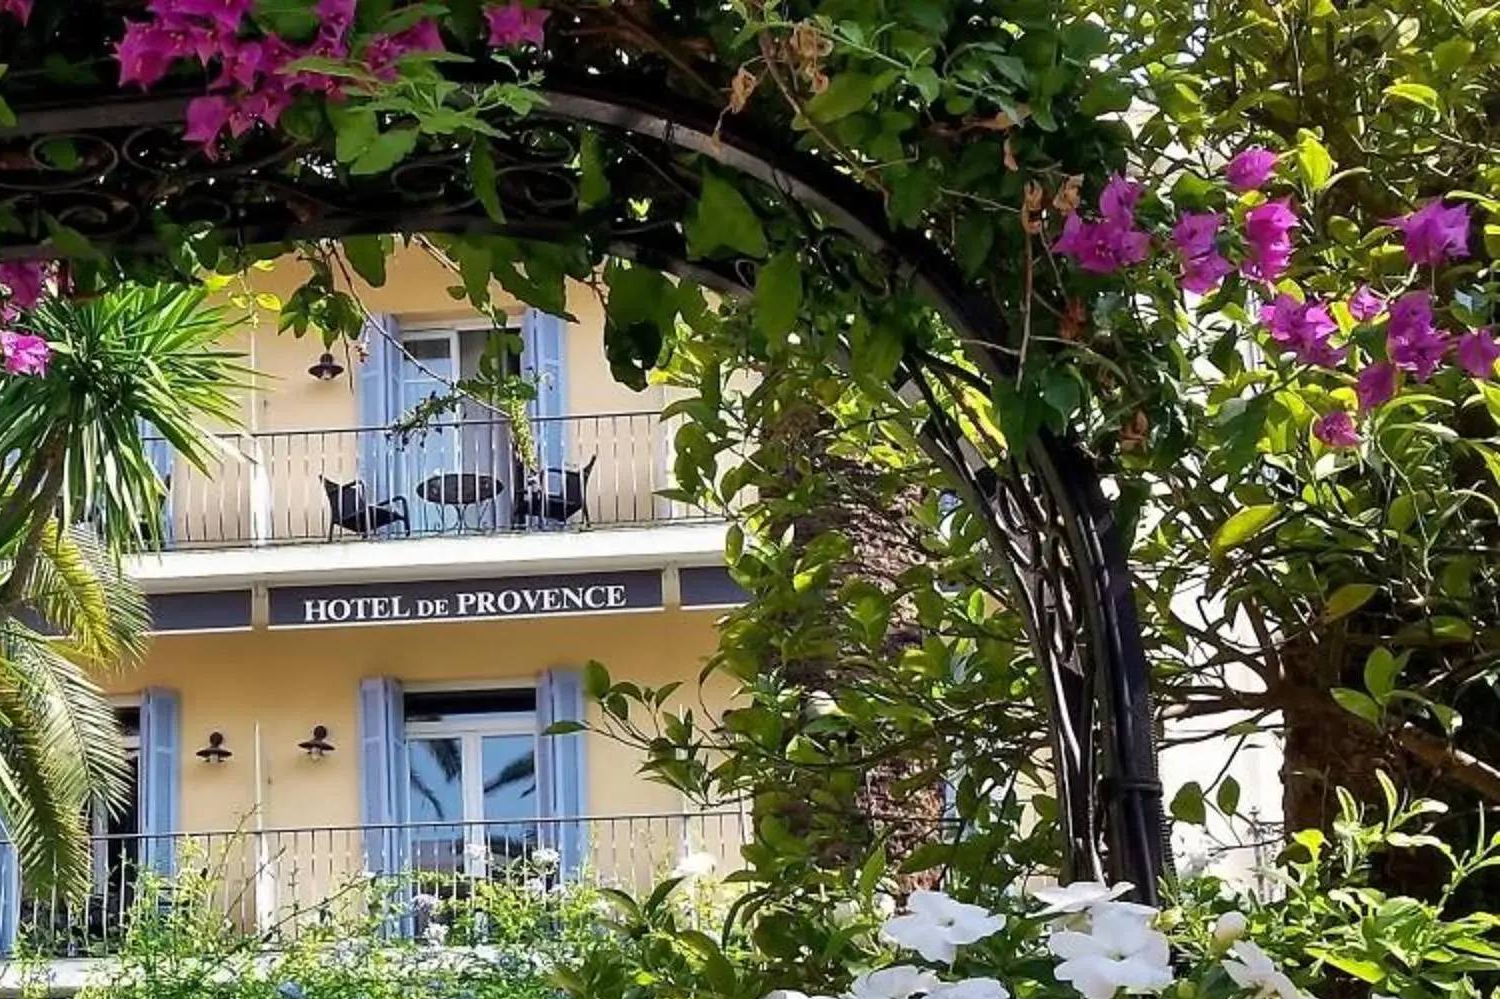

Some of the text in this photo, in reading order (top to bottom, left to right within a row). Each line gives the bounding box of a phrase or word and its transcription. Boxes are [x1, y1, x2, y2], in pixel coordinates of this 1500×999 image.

[304, 585, 627, 621] HOTEL DE PROVENCE
